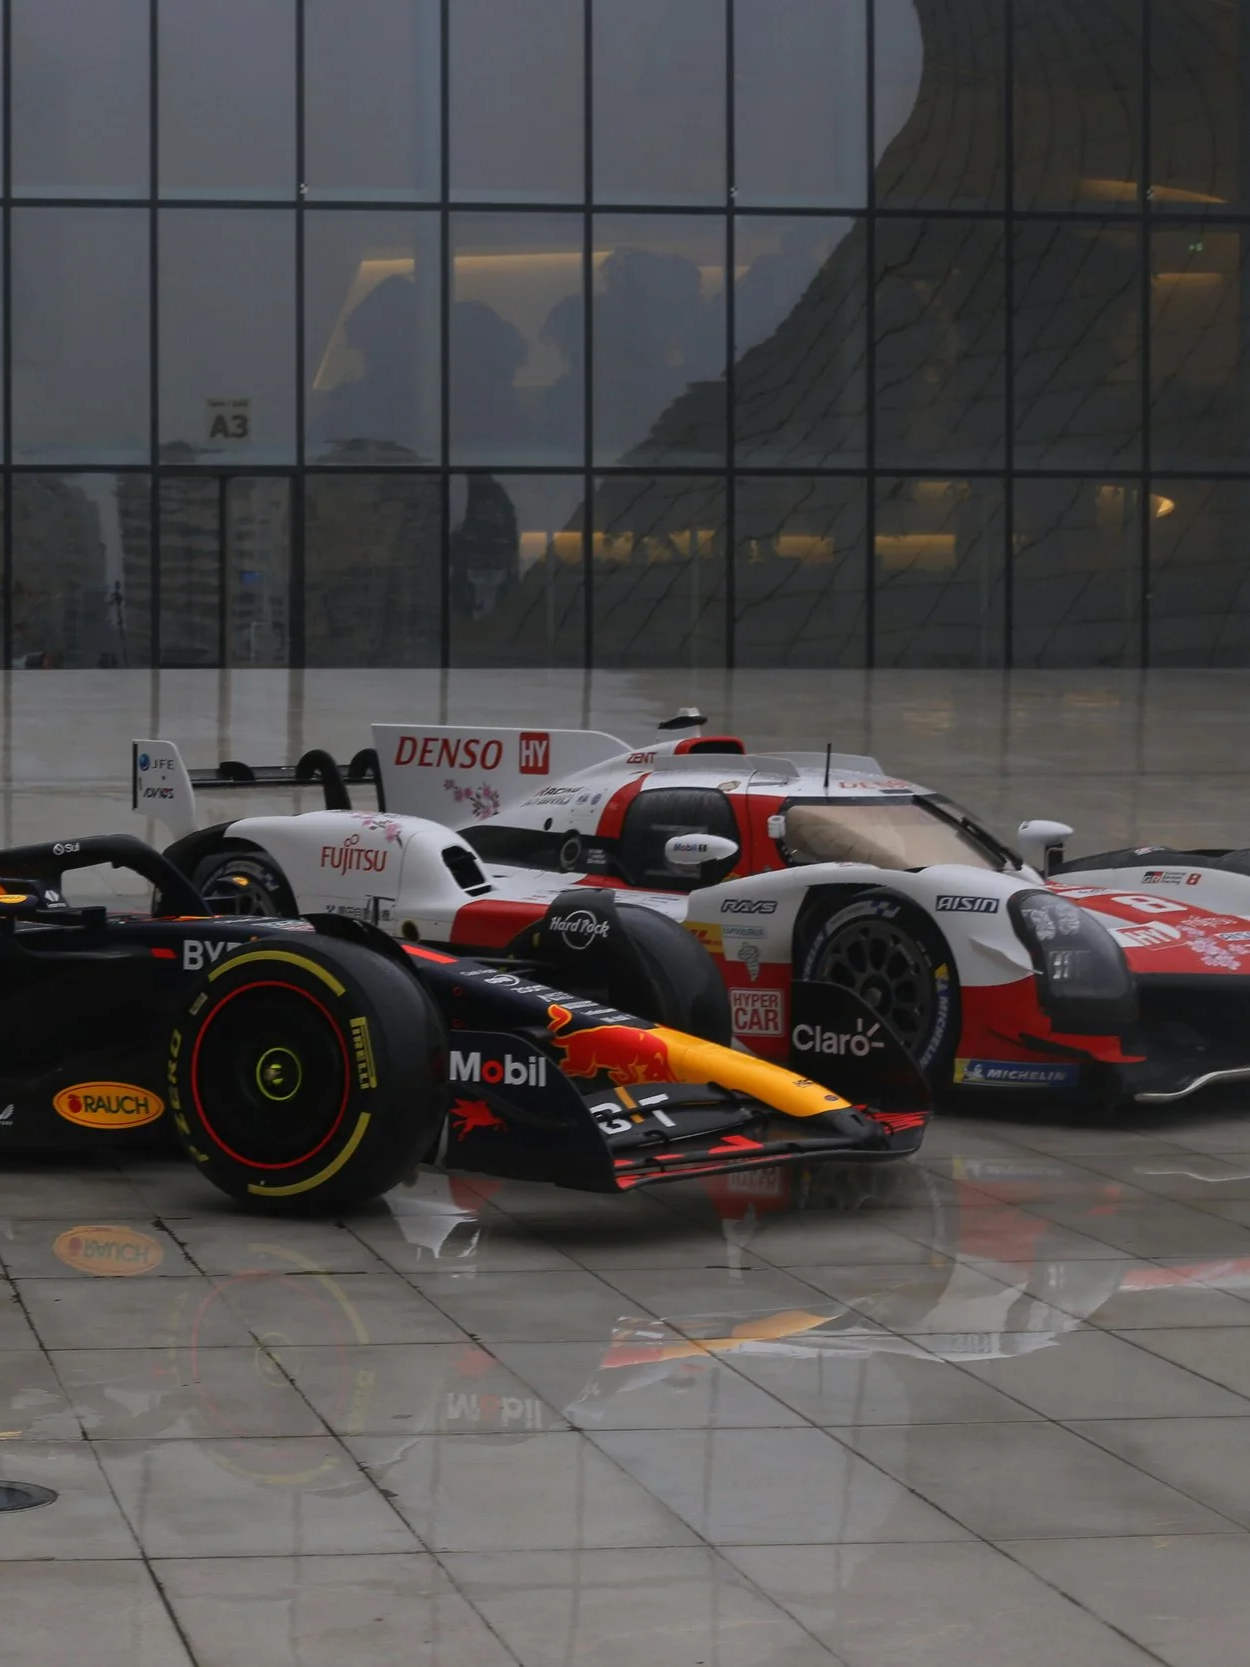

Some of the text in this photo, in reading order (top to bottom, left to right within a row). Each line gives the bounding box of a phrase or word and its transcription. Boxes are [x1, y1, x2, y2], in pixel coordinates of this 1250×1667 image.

[209, 413, 249, 439] A3
[394, 736, 548, 770] DENSO HY
[626, 752, 657, 764] ZENT
[151, 759, 174, 770] JFE
[320, 846, 387, 876] FUJITSU
[1186, 872, 1202, 886] 8
[721, 899, 778, 914] RAYS
[937, 896, 998, 912] AISIN
[549, 916, 611, 938] Hard Rock
[733, 993, 778, 1008] HYPER
[734, 1007, 779, 1031] CAR
[792, 1022, 872, 1057] Claro
[349, 1016, 378, 1090] PIRELLI
[449, 1050, 546, 1088] Mobil
[986, 1068, 1069, 1082] MICHELIN
[83, 1094, 149, 1115] RAUCH
